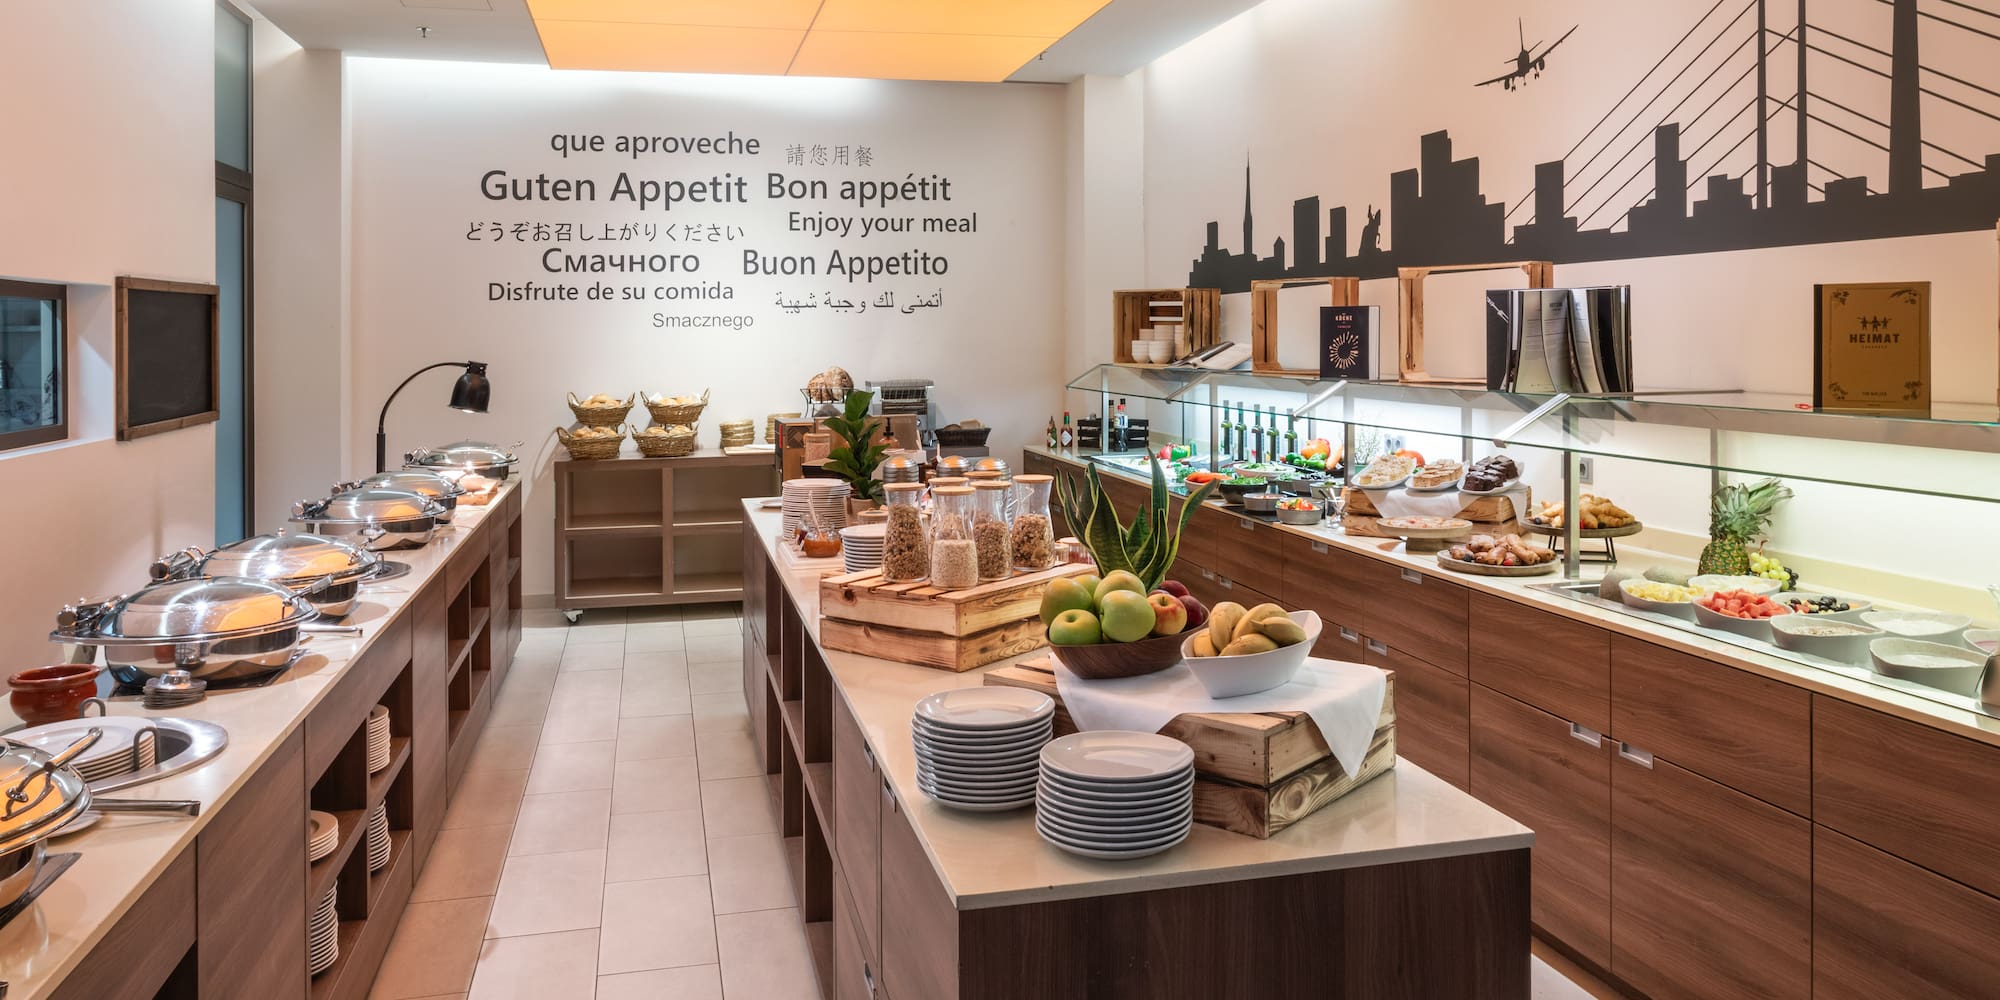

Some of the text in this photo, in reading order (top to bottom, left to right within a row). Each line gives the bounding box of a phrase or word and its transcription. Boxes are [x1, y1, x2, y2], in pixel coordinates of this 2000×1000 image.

[550, 131, 761, 159] que aproveche
[785, 143, 874, 167] 請您用餐
[480, 170, 748, 211] Guten Appetit
[768, 173, 952, 208] Bon appétit
[466, 221, 745, 243] どうぞお召し上がりください
[788, 211, 978, 239] Enjoy your meal
[541, 248, 701, 274] Смачного
[743, 249, 949, 284] Buon Appetito
[488, 281, 734, 302] Disfrute de su comida
[775, 288, 943, 315] أتمنى لك وجبة شهية
[652, 313, 754, 331] Smacznego
[1849, 334, 1900, 344] HEIMAT
